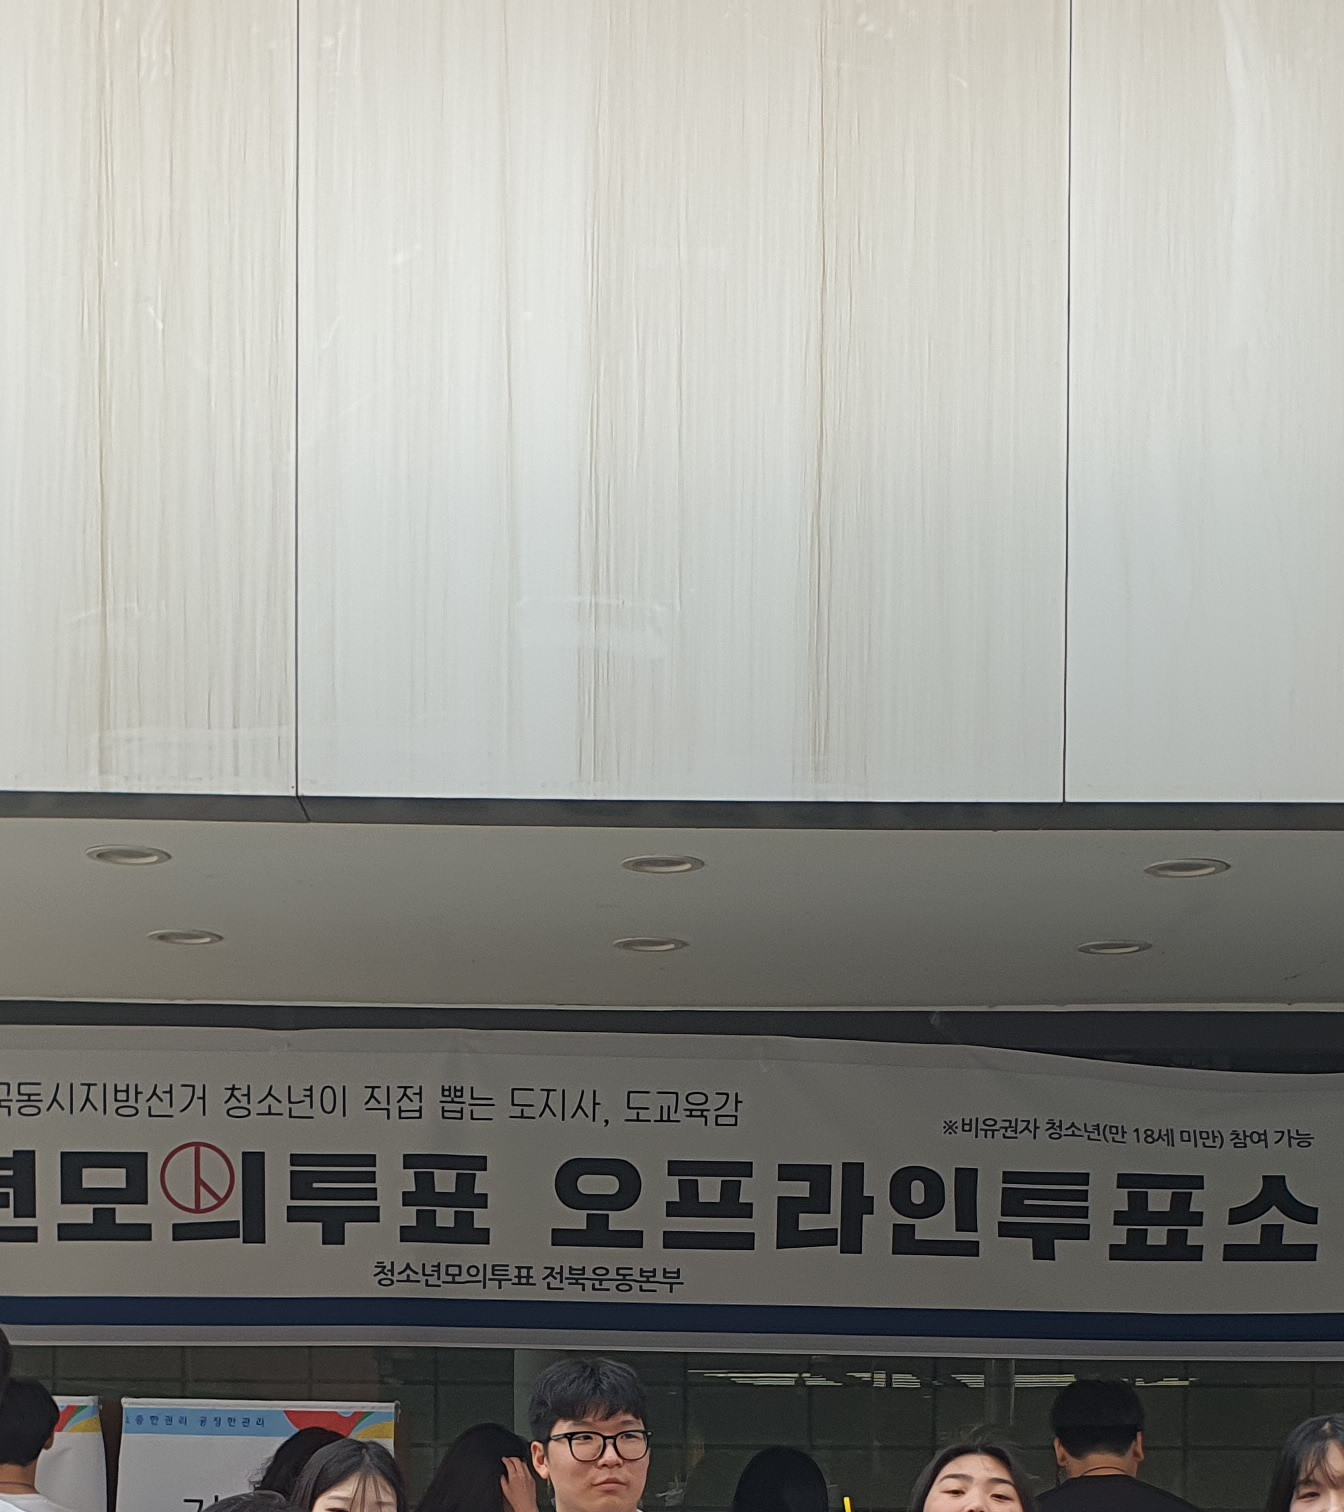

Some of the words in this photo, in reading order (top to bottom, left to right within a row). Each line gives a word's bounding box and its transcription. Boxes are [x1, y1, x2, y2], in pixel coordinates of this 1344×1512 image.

[222, 1081, 349, 1121] 청소년이
[362, 1083, 426, 1121] 직접
[438, 1084, 496, 1123] 뽑는
[508, 1086, 612, 1127] 도지사,
[623, 1088, 744, 1129] 도교육감
[1045, 1116, 1127, 1146] 청소년(만
[1131, 1123, 1175, 1148] 18세
[1179, 1125, 1225, 1151] 미만)
[1228, 1127, 1268, 1150] 참여
[1272, 1127, 1315, 1150] 가능
[551, 1155, 1320, 1264] 오프라인투표소
[372, 1258, 537, 1290] 청소년모의투표
[541, 1262, 686, 1294] 전북운동본부
